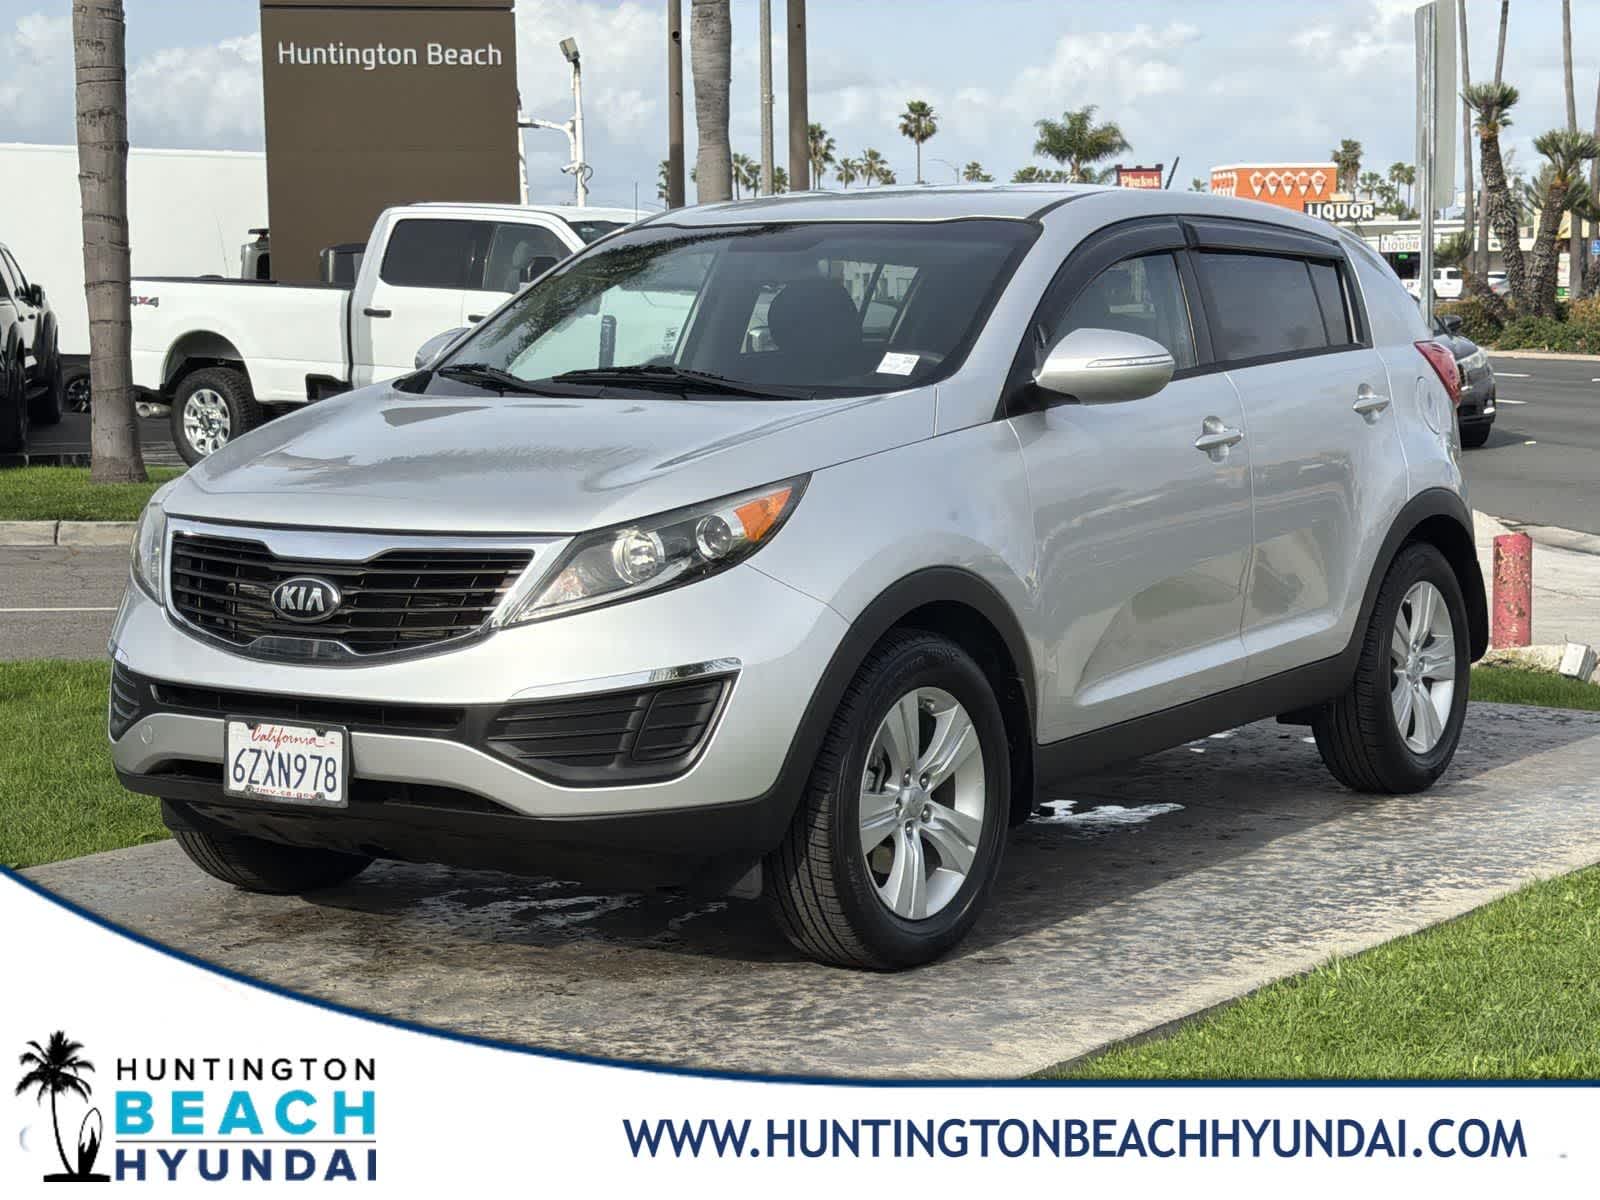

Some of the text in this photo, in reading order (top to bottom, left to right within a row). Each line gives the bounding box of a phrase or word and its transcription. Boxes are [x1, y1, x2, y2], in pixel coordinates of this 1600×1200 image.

[278, 42, 502, 70] Huntington Beach
[1307, 203, 1374, 221] LIQUOR
[280, 585, 325, 612] KIA
[251, 724, 325, 749] California
[232, 747, 338, 794] 6ZXN978
